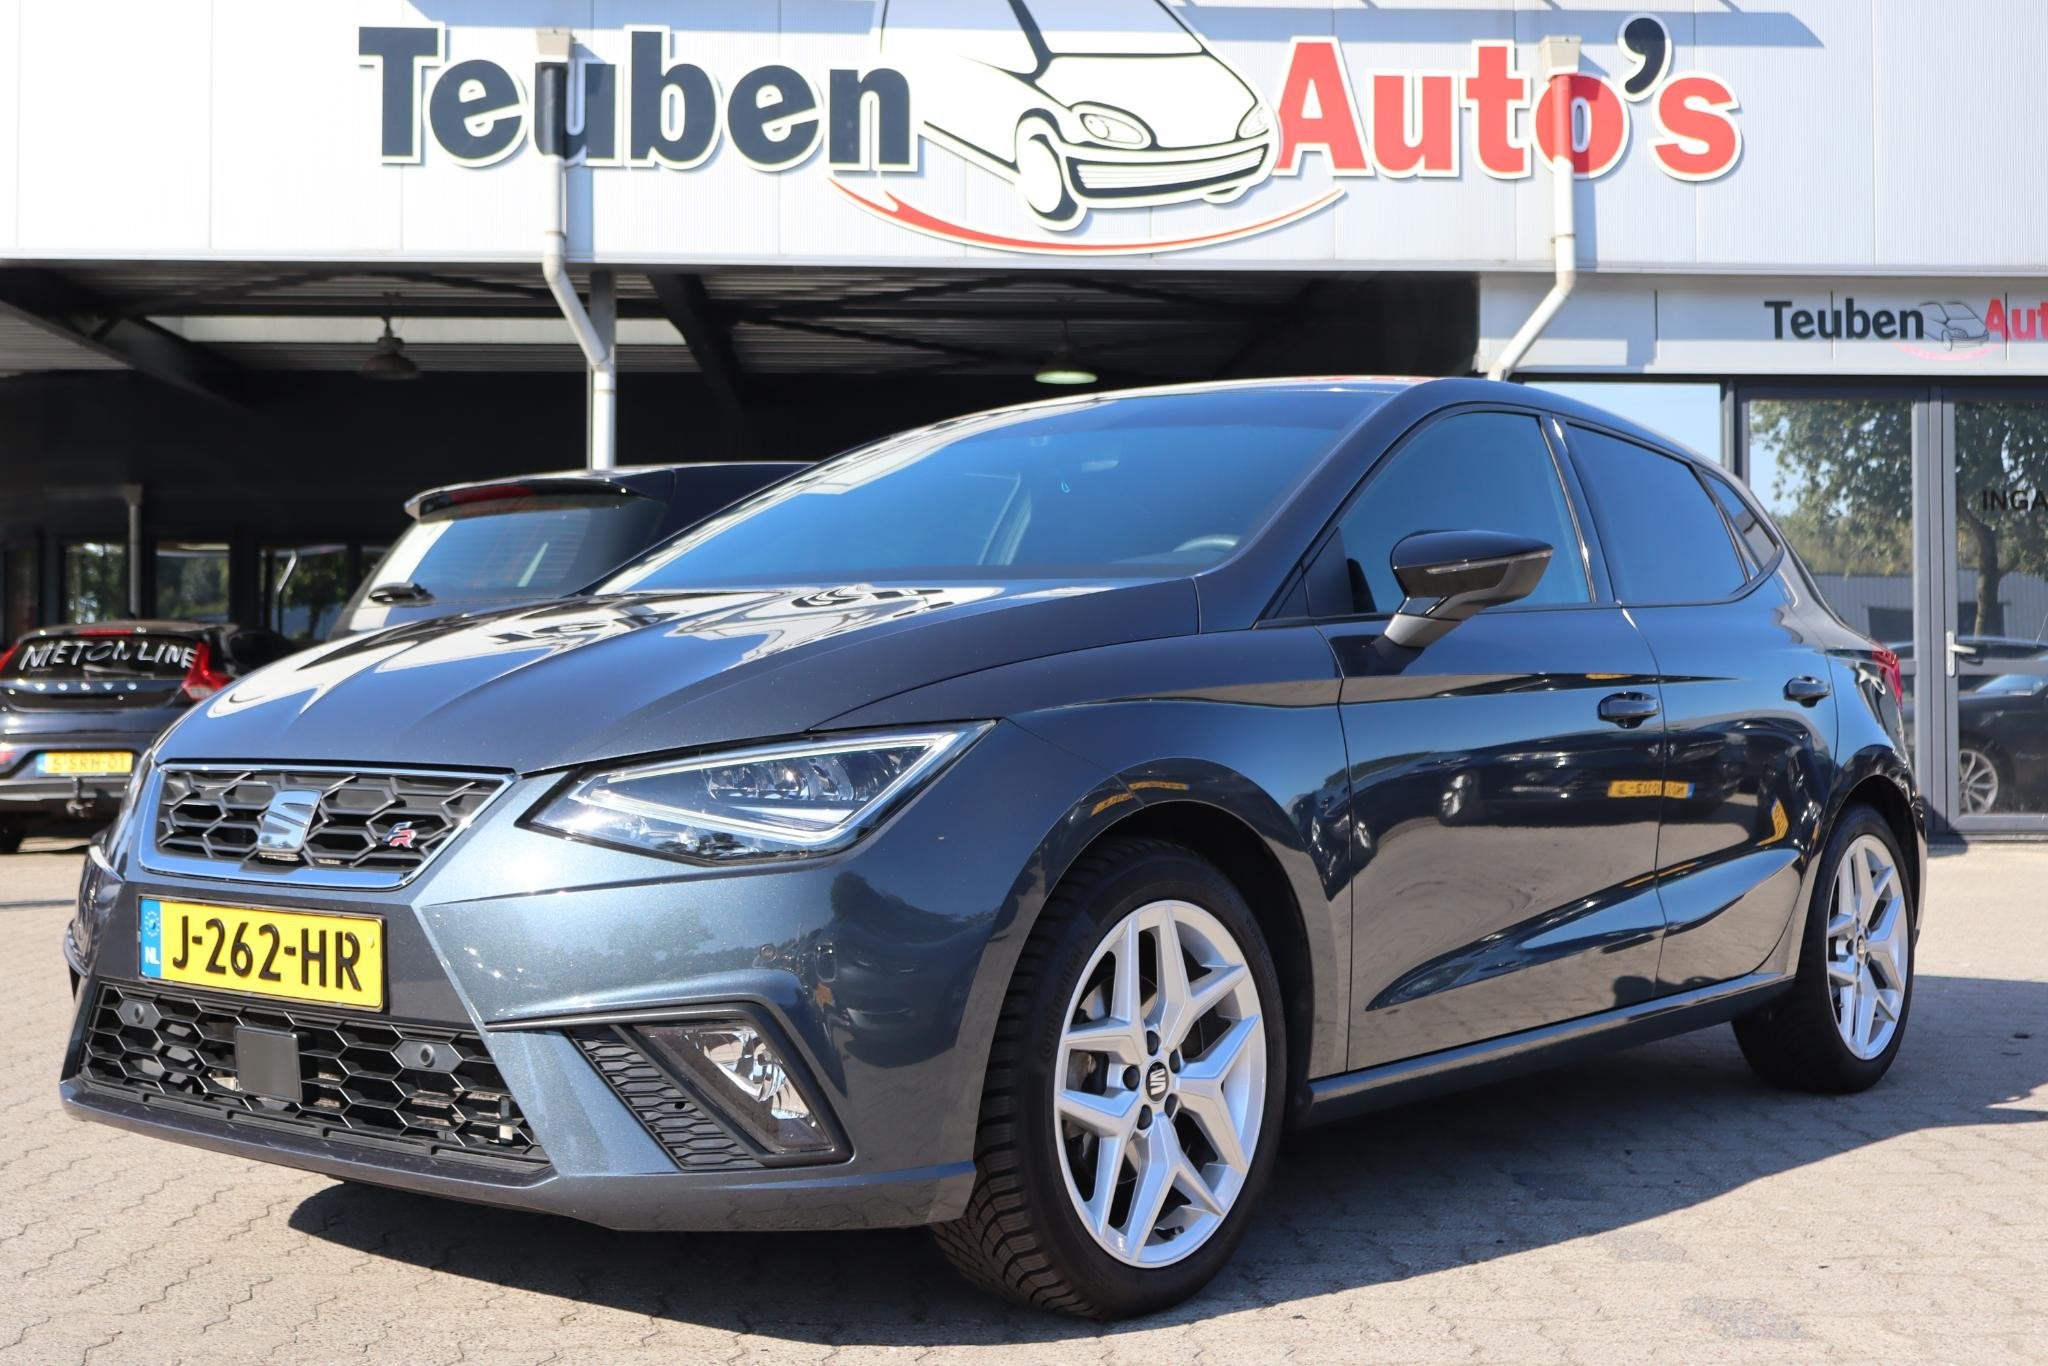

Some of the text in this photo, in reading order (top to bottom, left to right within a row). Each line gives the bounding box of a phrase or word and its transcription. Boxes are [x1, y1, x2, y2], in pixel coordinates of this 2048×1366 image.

[358, 17, 1738, 175] Teuben Auto's
[1763, 296, 1925, 341] Teuben
[144, 946, 161, 965] NL
[172, 914, 363, 992] J-262-HR
